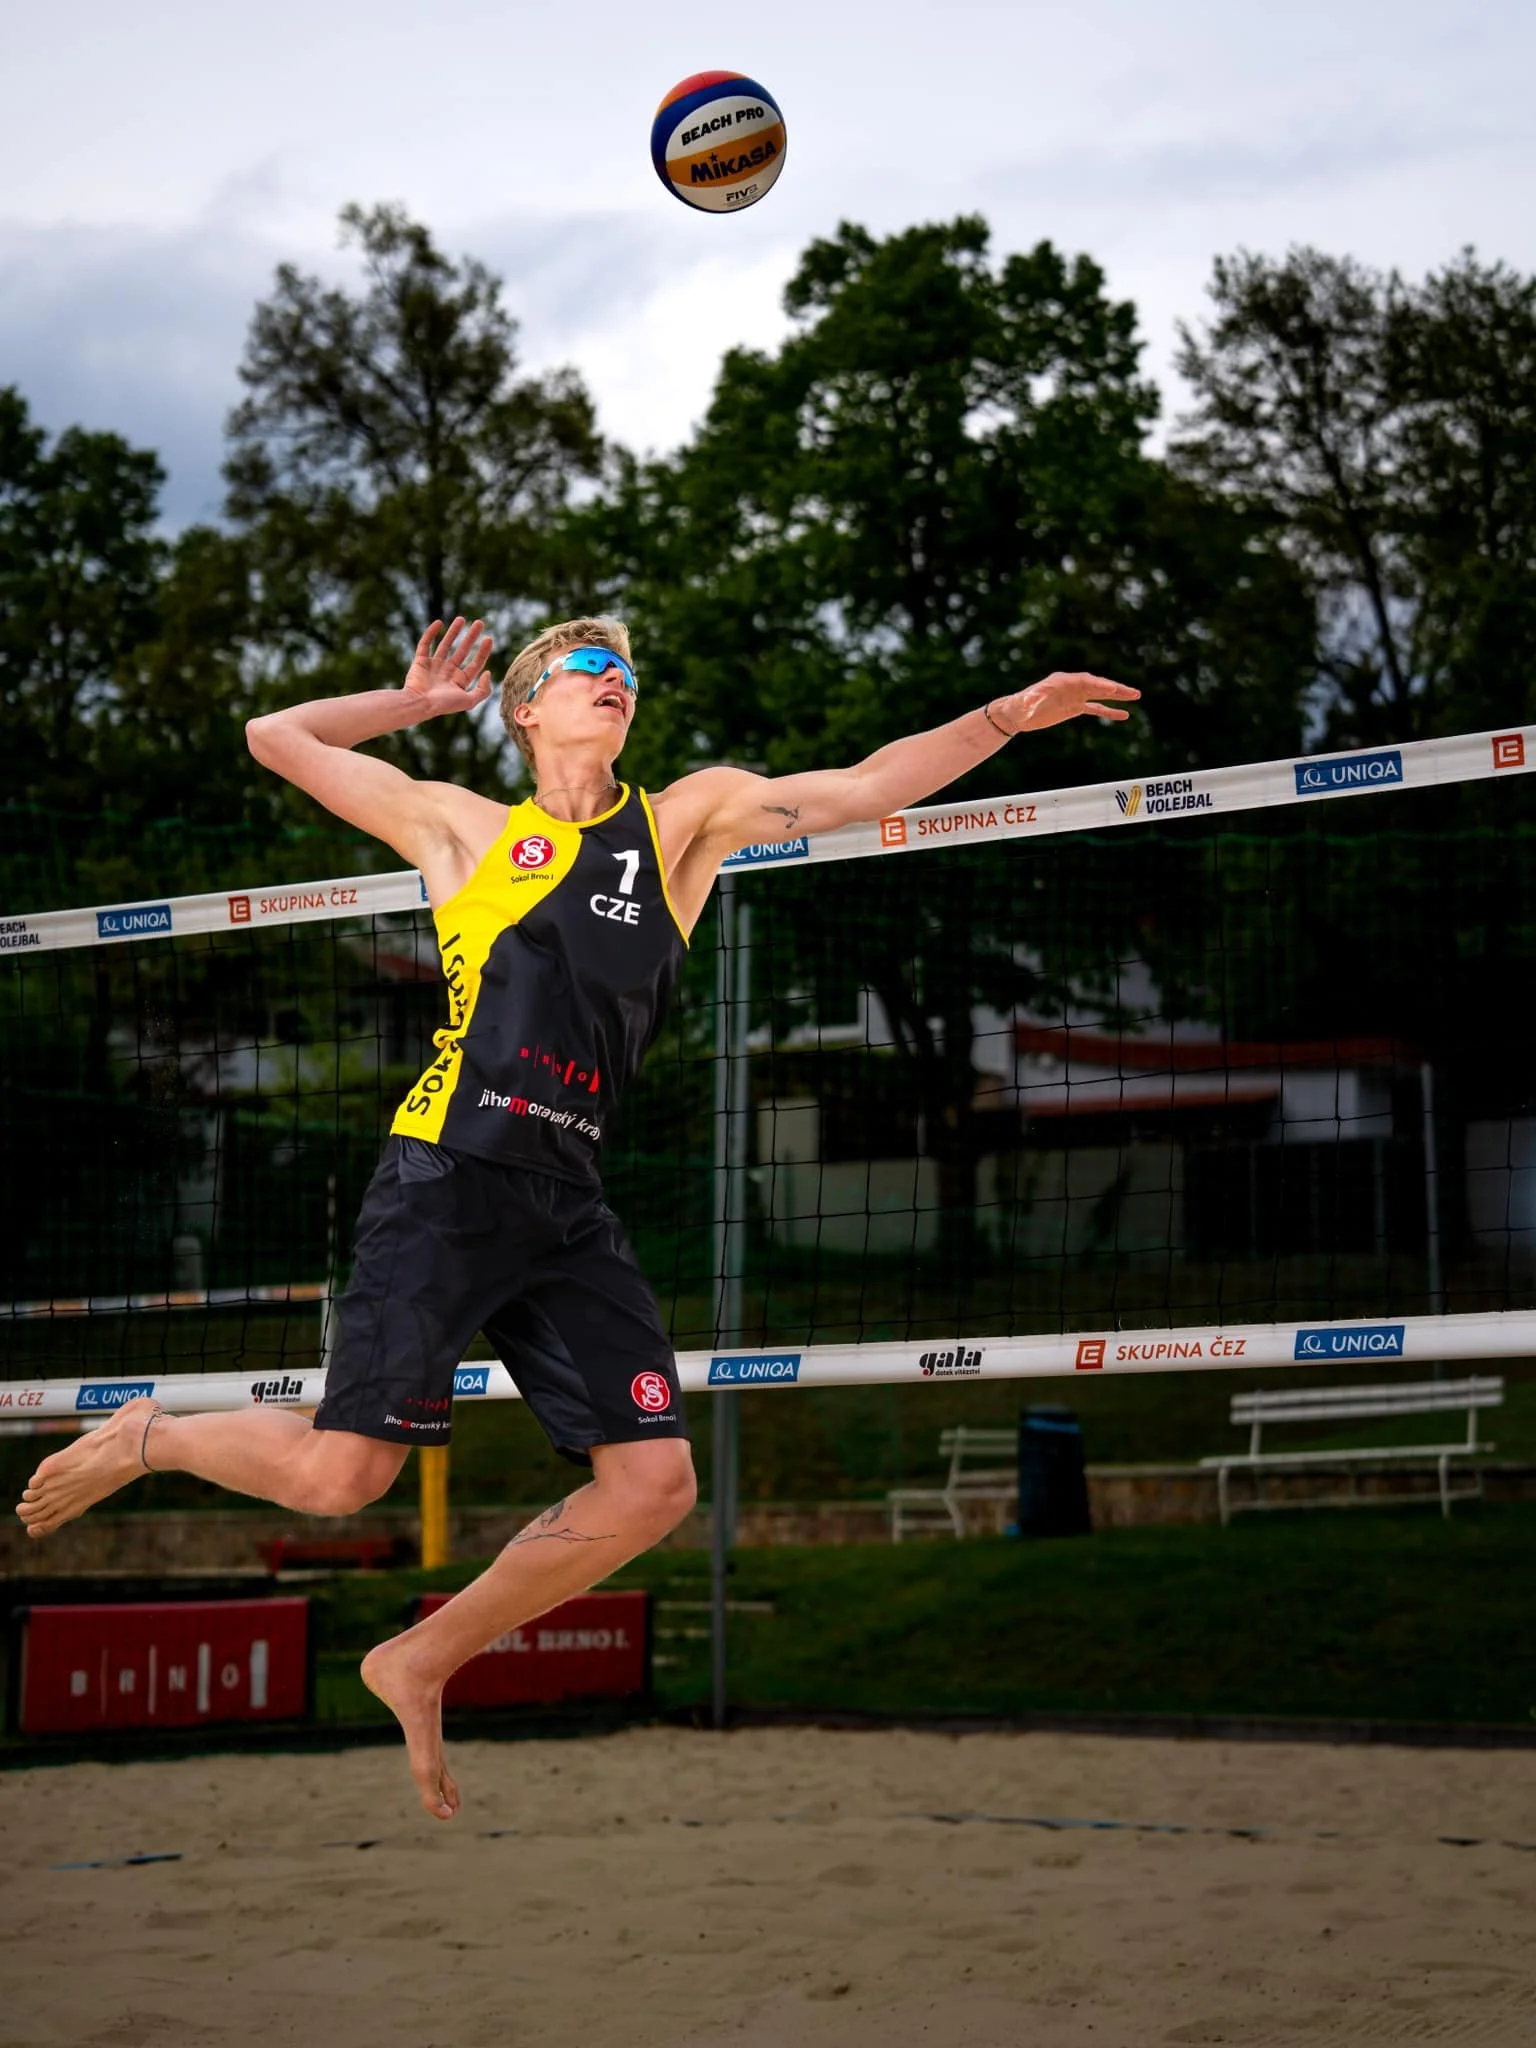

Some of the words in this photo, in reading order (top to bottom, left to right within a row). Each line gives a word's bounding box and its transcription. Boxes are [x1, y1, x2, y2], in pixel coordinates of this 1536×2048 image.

[681, 114, 732, 146] BEACH
[736, 106, 765, 124] PRO
[1332, 760, 1398, 785] UNIQA
[1146, 780, 1193, 798] BEACH
[1146, 794, 1213, 815] VOLEJBAL
[918, 813, 998, 836] SKUPINA
[1004, 804, 1037, 825] ČEZ
[749, 838, 805, 857] UNIQA
[611, 850, 640, 895] 1
[260, 894, 326, 915] SKUPINA
[330, 887, 358, 907] ČEZ
[589, 893, 642, 925] CZE
[0, 921, 26, 935] EACH
[123, 913, 170, 931] UNIQA
[0, 933, 41, 948] OLEJBAL
[478, 1088, 578, 1128] jihomoravský
[1116, 1341, 1201, 1361] SKUPINA
[1210, 1335, 1247, 1357] ČEZ
[1332, 1333, 1399, 1354] UNIQA
[739, 1361, 795, 1379] UNIQA
[919, 1346, 983, 1376] gala
[18, 1389, 45, 1407] ČEZ
[251, 1376, 303, 1403] gala
[484, 1630, 530, 1653] OL
